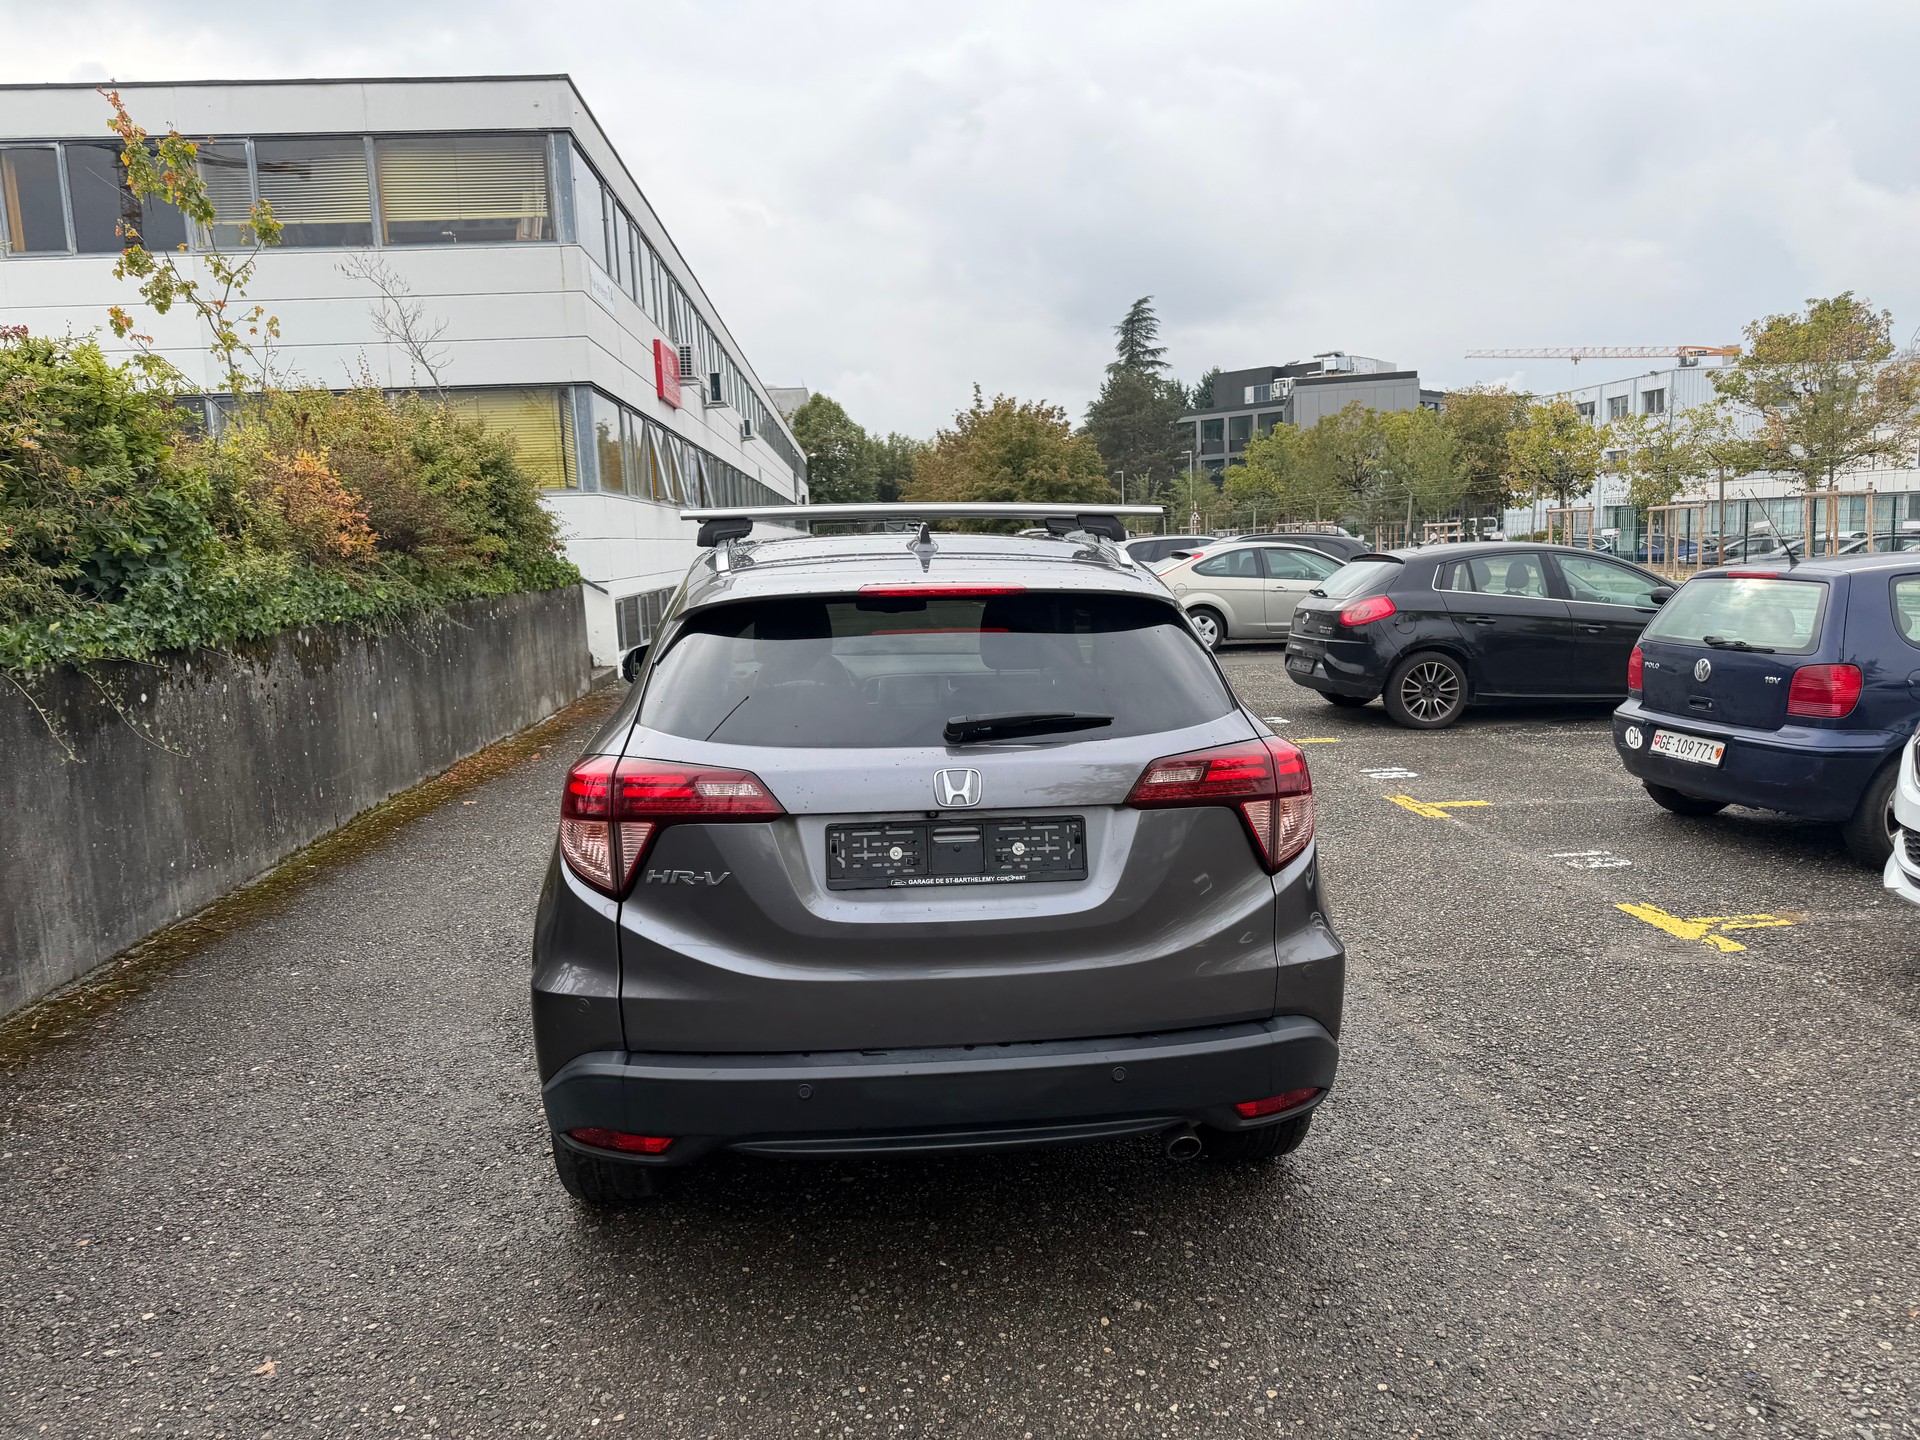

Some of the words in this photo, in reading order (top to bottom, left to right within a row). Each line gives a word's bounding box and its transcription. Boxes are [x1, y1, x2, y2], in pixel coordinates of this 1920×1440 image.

[1644, 661, 1660, 669] POLO
[1629, 728, 1640, 747] CH
[646, 869, 731, 886] HR-V
[945, 875, 995, 884] ST-BARTHELEMY
